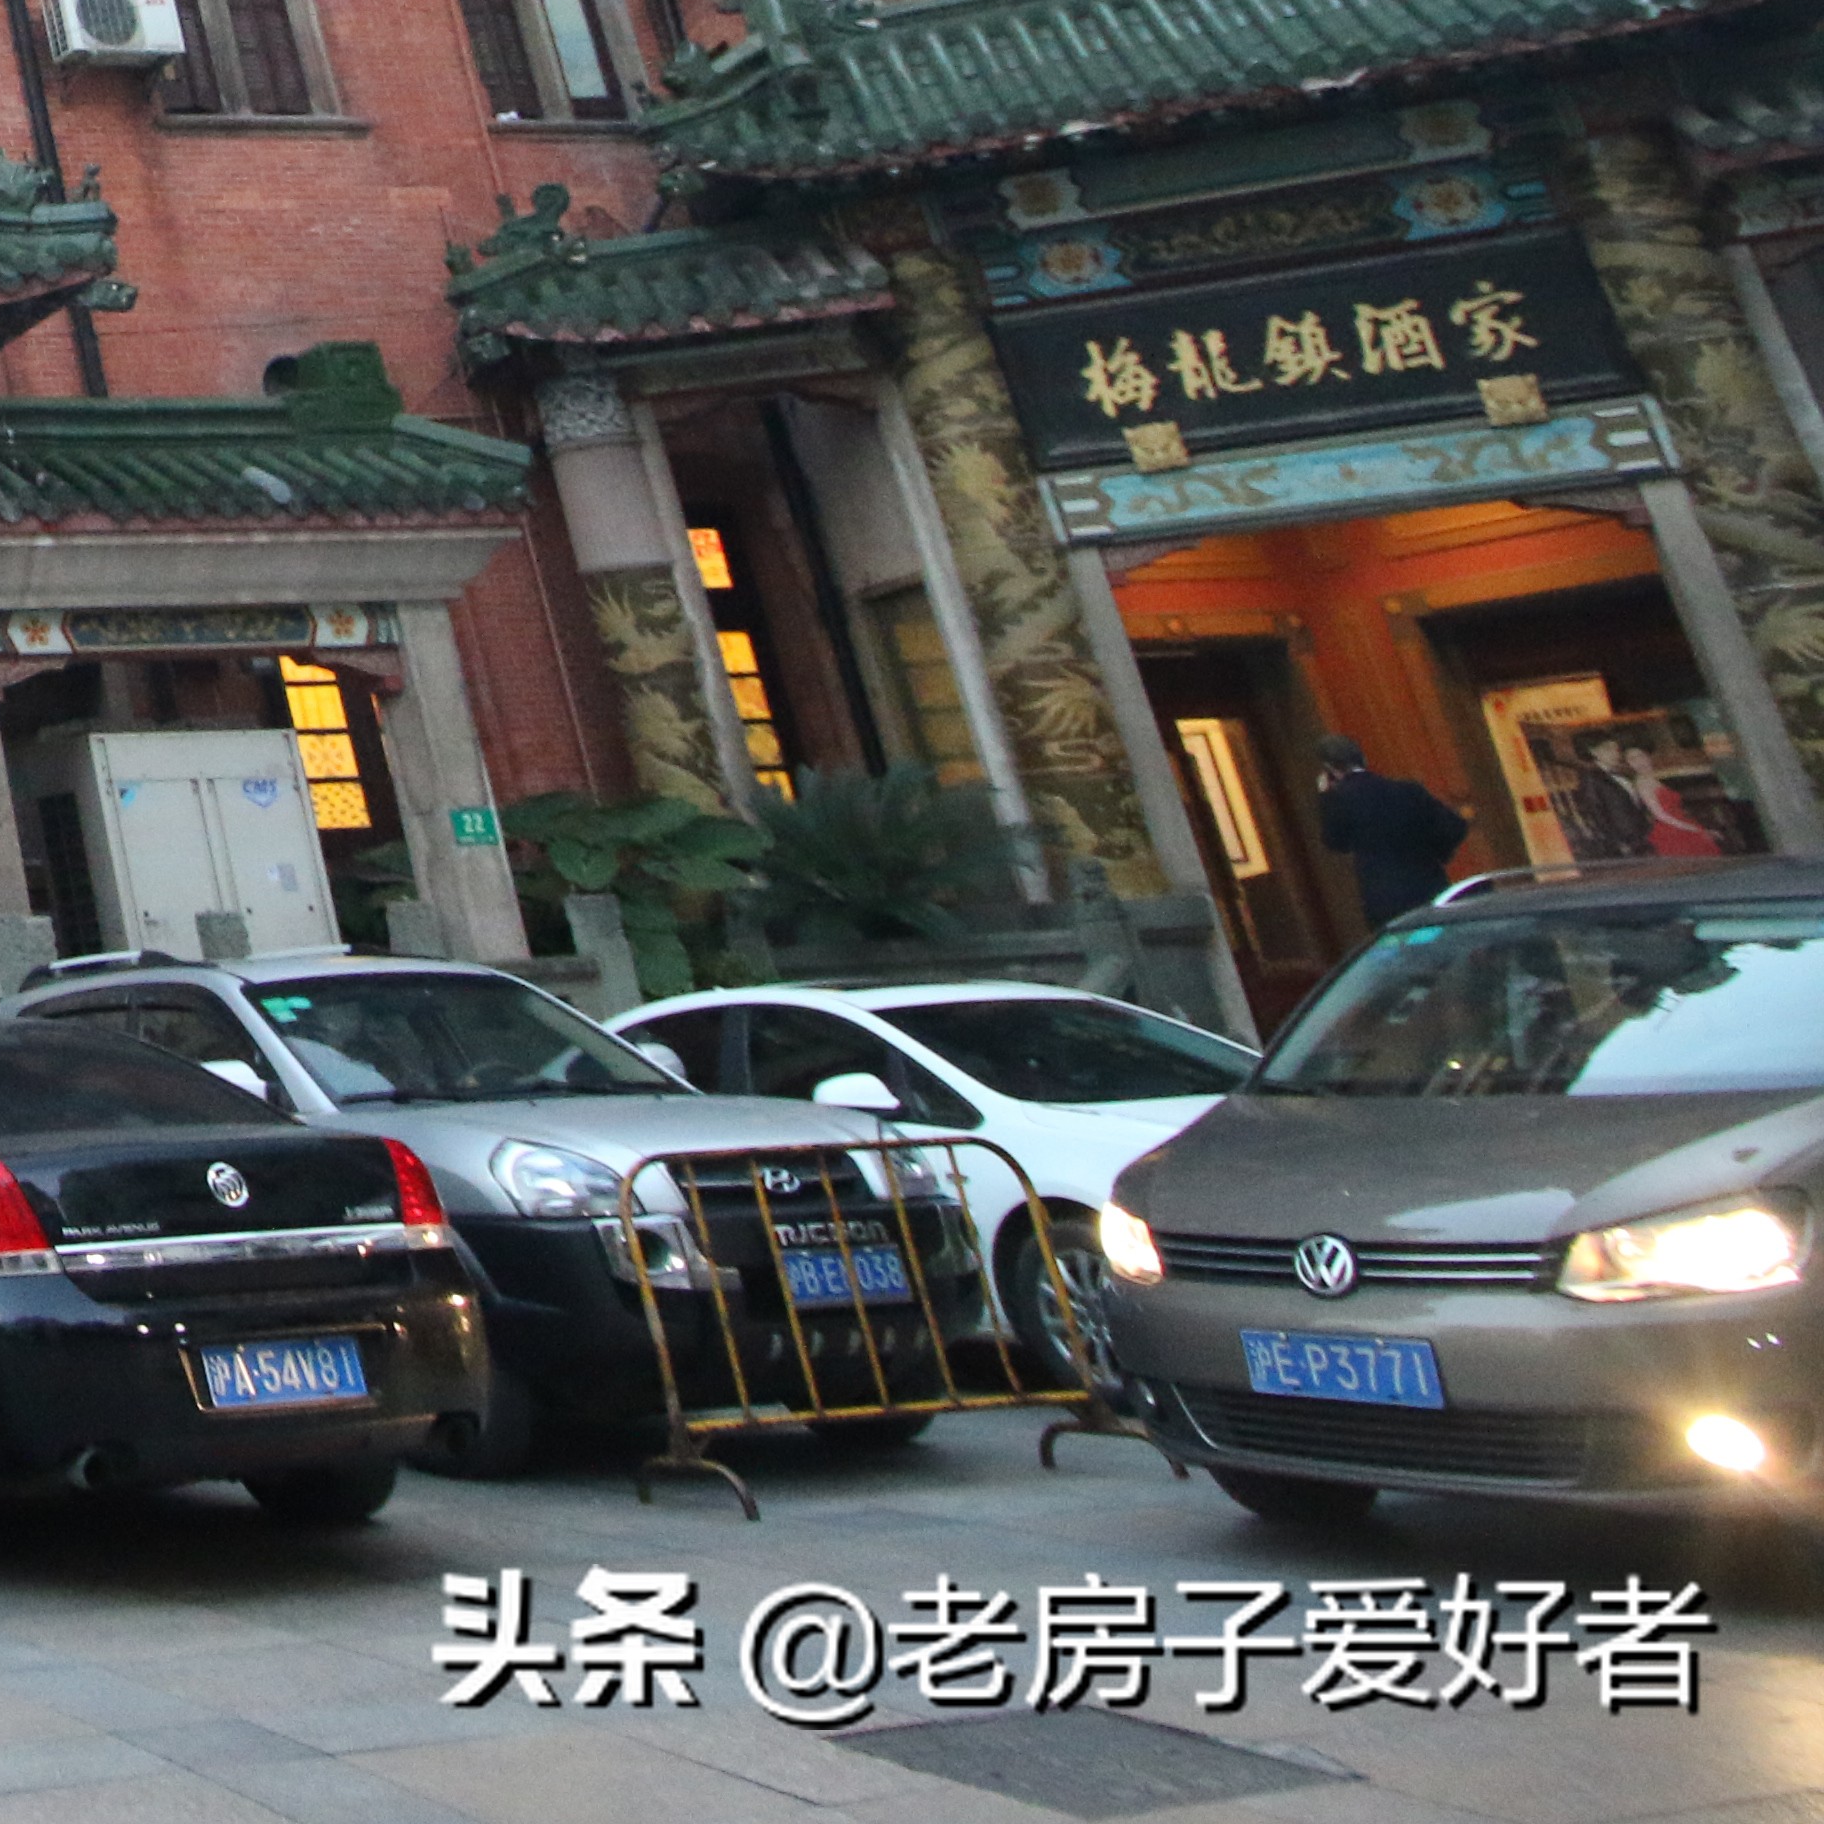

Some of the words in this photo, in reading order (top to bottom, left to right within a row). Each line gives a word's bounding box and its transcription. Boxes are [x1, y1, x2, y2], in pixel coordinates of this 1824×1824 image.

[1082, 281, 1539, 418] 梅龍鎮酒家
